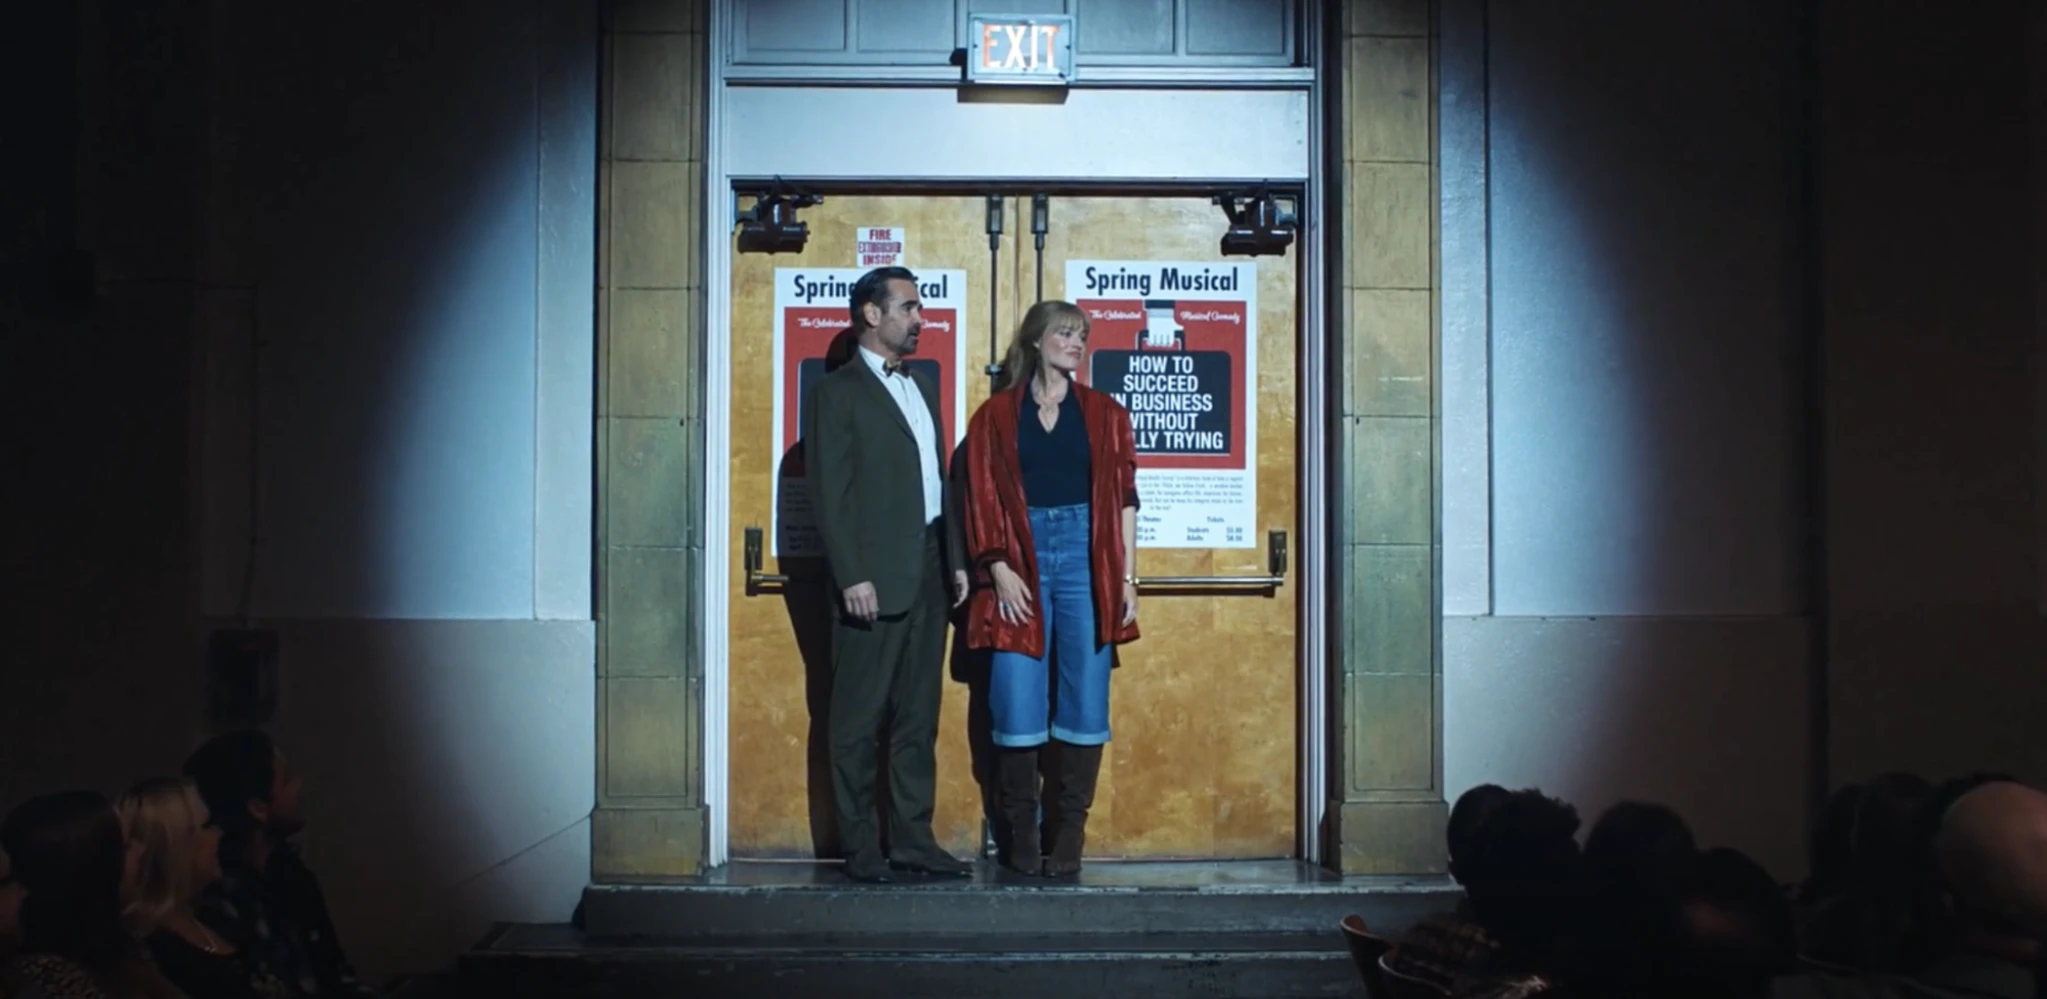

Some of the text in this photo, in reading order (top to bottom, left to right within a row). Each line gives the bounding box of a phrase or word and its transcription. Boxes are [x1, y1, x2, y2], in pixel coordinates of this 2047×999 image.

[983, 24, 1059, 69] EXIT
[869, 229, 892, 240] FIRE
[1086, 266, 1238, 296] Spring Musical
[798, 318, 811, 327] The
[1089, 310, 1141, 320] The Celebrated
[1129, 355, 1194, 374] HOW TO
[1123, 374, 1198, 392] SUCCEED
[1132, 393, 1213, 411] BUSINESS
[1163, 431, 1224, 449] TRYING
